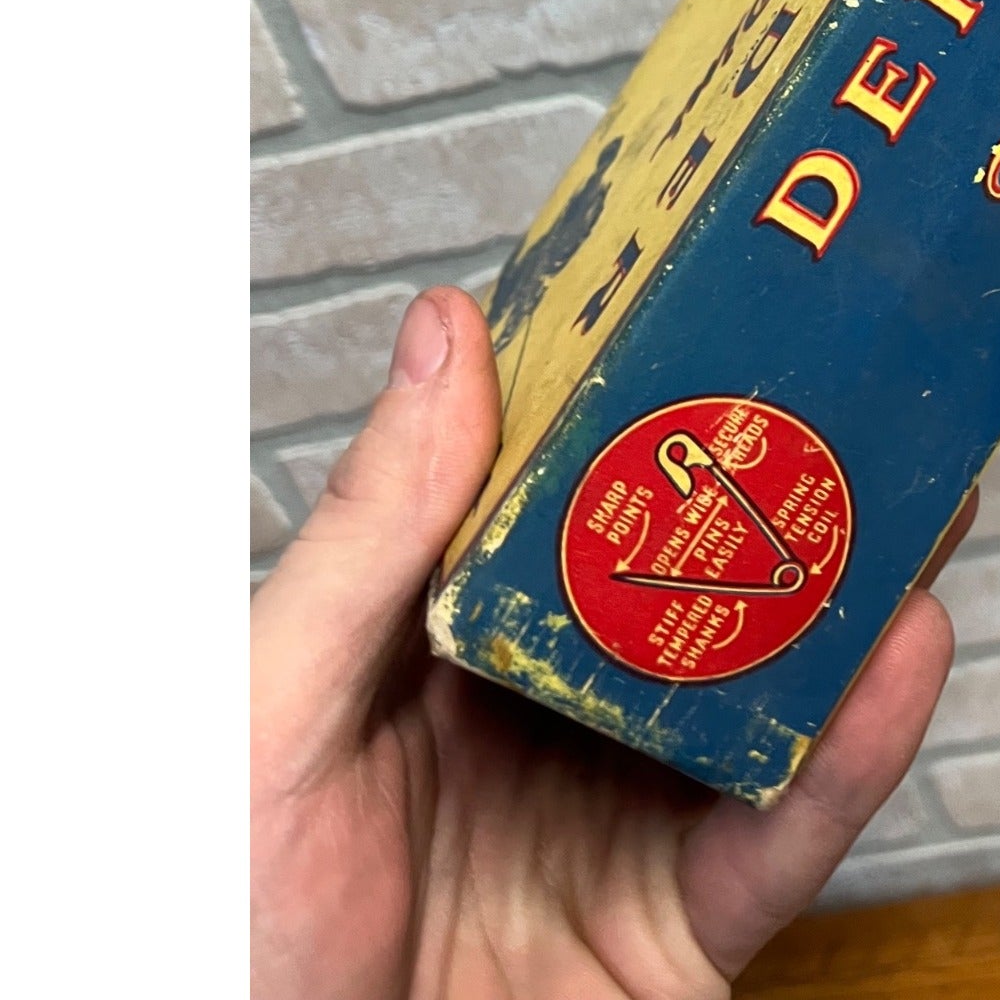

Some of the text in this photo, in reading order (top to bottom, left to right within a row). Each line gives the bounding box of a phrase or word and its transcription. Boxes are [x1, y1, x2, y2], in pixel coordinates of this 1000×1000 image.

[708, 404, 750, 457] SECURE
[729, 414, 769, 462] HEADS
[586, 479, 629, 535] SHARP
[606, 485, 654, 545] POINTS
[771, 472, 816, 529] SPRING
[783, 477, 837, 544] TENSION
[806, 510, 838, 545] COIL
[650, 484, 719, 576] OPENS WIDE
[693, 516, 731, 562] PINS
[704, 520, 749, 580] EASILY
[648, 599, 686, 647] STIFF
[656, 595, 714, 668] TEMPERED
[680, 603, 731, 670] SHANKS
